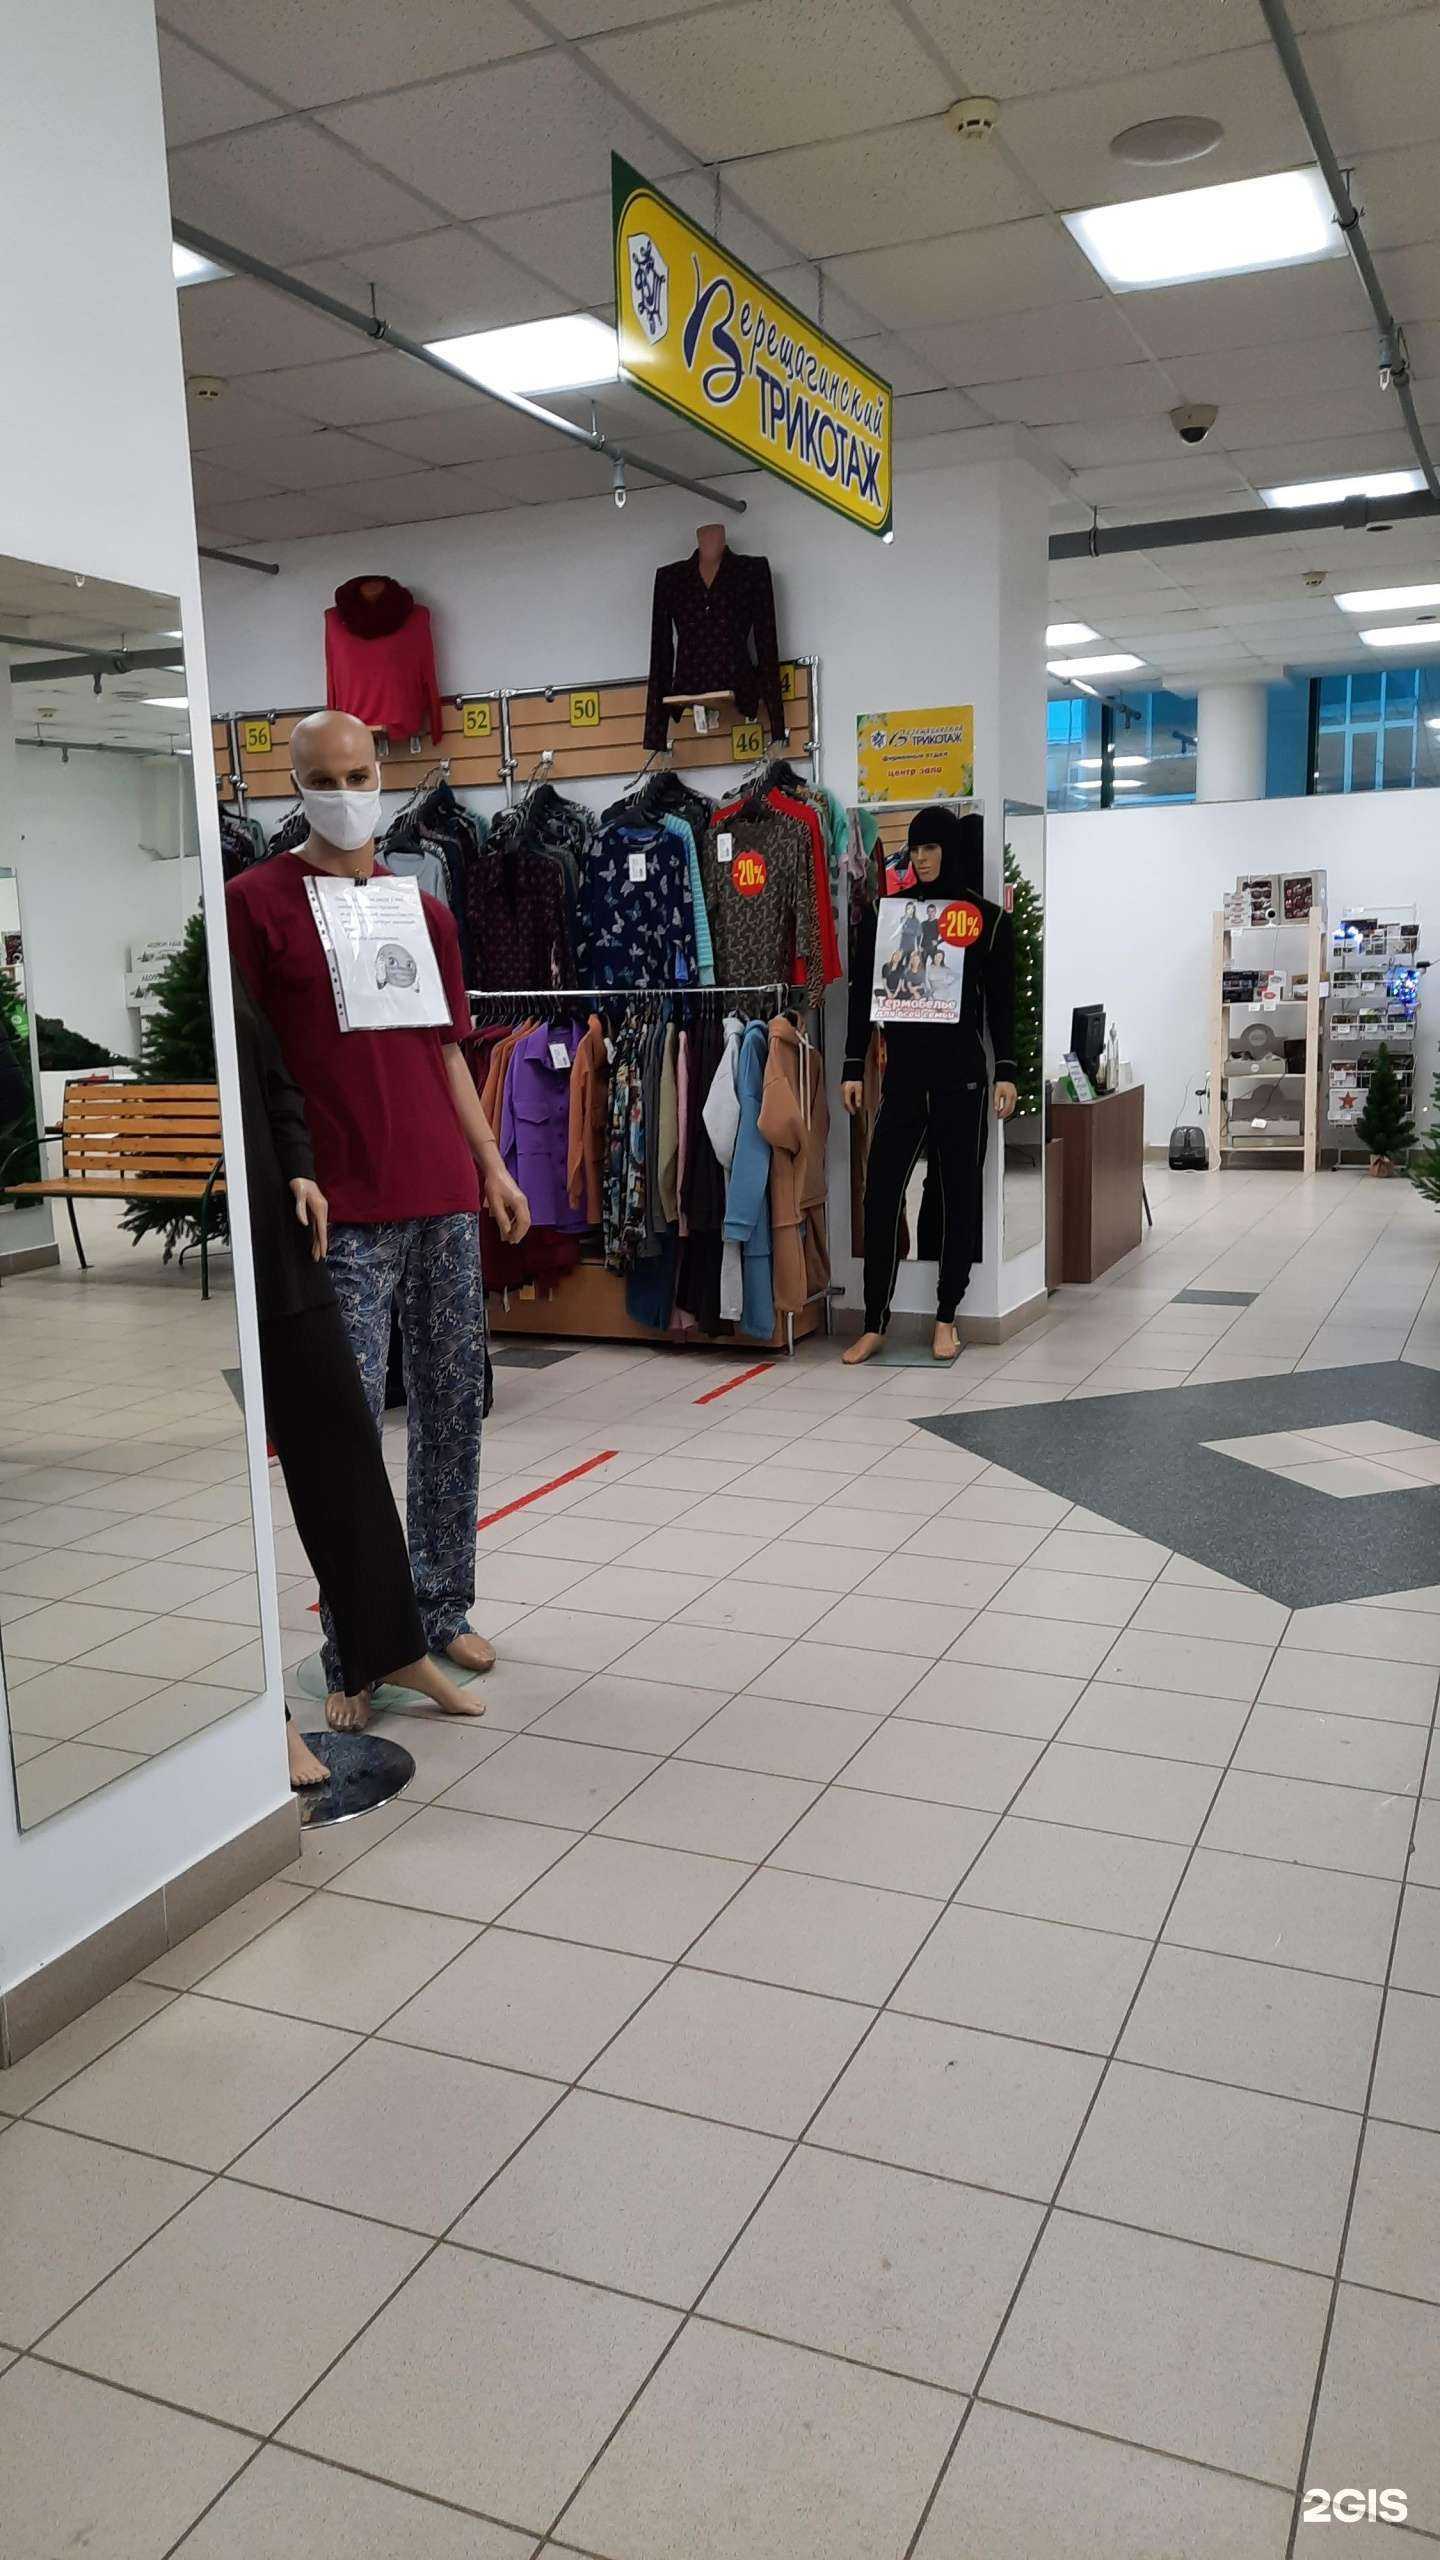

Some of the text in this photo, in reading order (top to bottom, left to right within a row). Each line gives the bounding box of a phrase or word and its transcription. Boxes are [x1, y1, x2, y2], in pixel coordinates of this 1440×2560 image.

[684, 254, 884, 438] Верещагинский
[756, 366, 882, 507] ТРИКОТАЖ
[574, 699, 595, 719] 50
[466, 711, 488, 729] 52
[248, 728, 268, 746] 56
[736, 732, 760, 752] 46
[913, 733, 962, 746] ТРИКОТАЖ
[733, 859, 764, 886] -20%
[939, 910, 979, 937] -20%
[878, 997, 956, 1010] Термобелье
